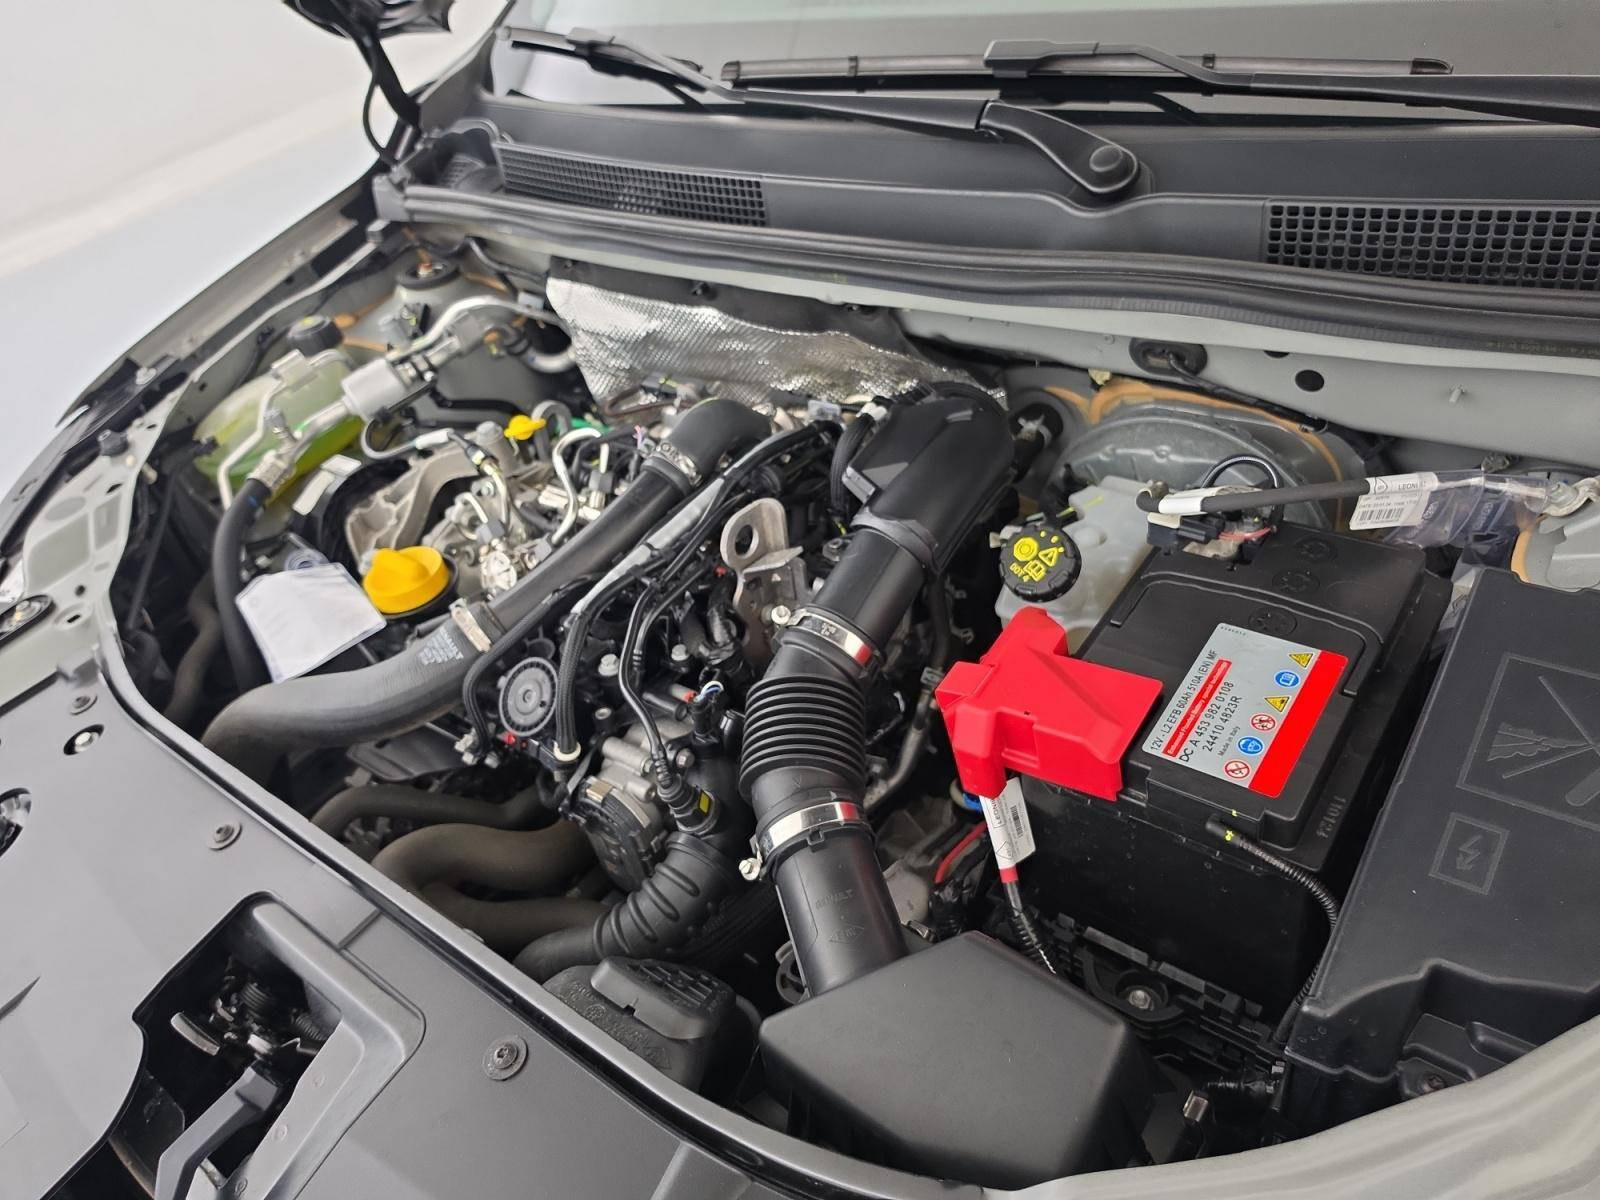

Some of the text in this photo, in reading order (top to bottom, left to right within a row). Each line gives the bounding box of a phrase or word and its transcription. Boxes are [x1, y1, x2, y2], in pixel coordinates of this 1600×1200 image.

[1150, 737, 1164, 751] 12V
[1160, 723, 1172, 735] L2
[1166, 708, 1182, 724] EFB
[1176, 691, 1193, 709] 60Ah
[1187, 675, 1202, 691] 510A
[1198, 660, 1213, 675] (EN)
[1206, 649, 1218, 660] MF
[1214, 681, 1234, 703] 0108
[1204, 703, 1221, 720] 982
[1194, 720, 1211, 737] 453
[1202, 724, 1225, 752] 24410
[1219, 695, 1243, 723] 4823R
[1189, 739, 1201, 748] A
[1178, 747, 1194, 763] DC
